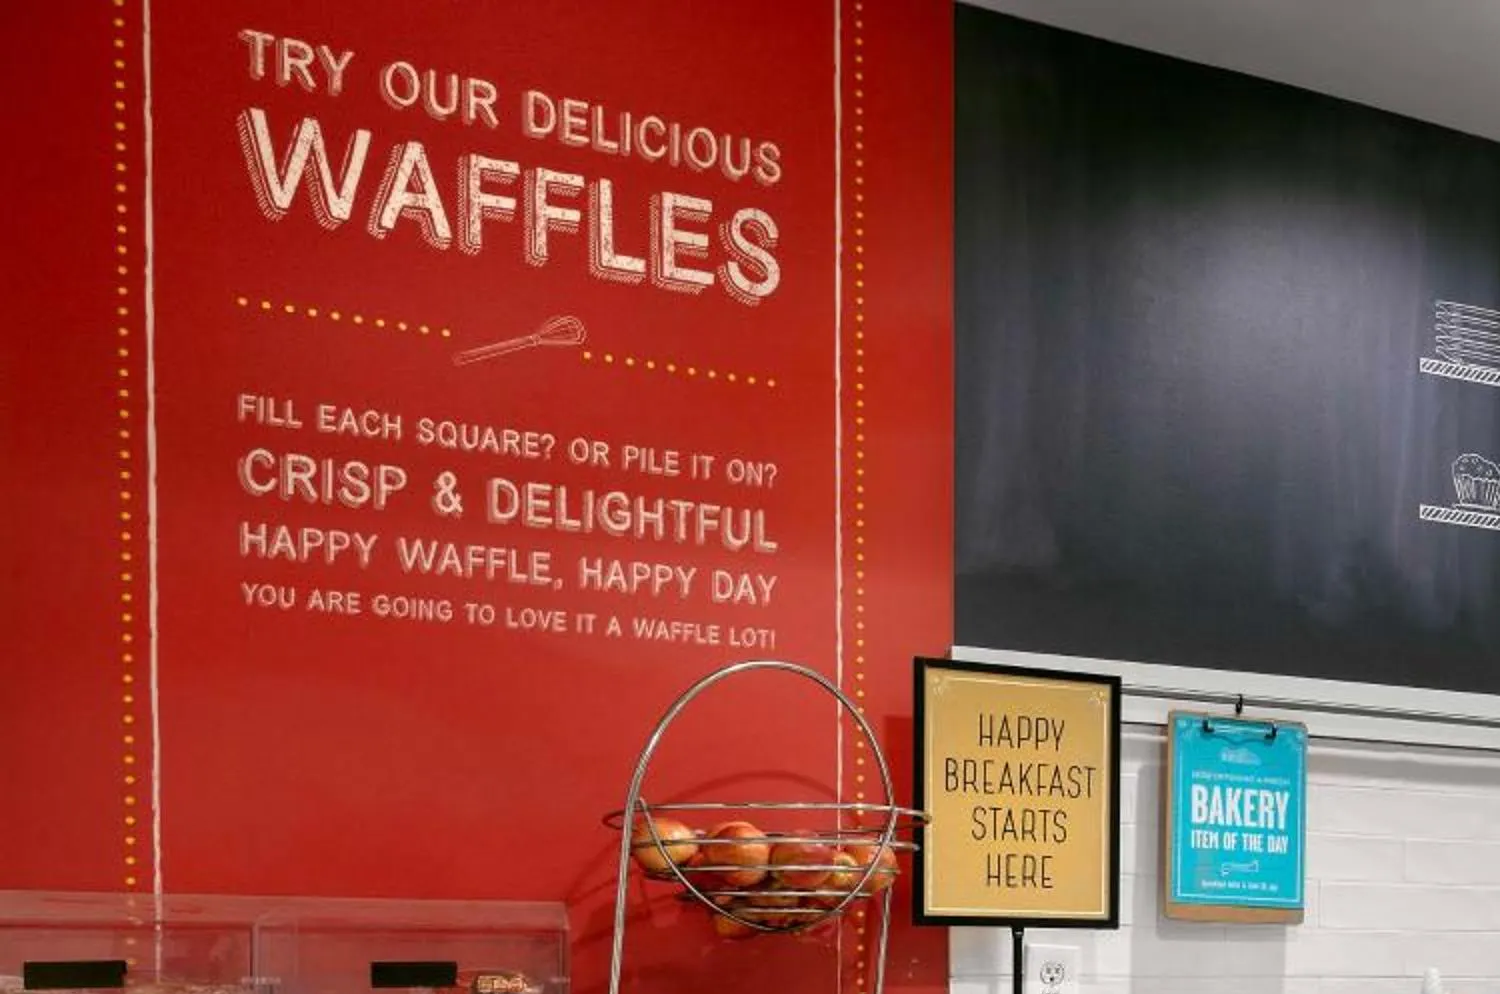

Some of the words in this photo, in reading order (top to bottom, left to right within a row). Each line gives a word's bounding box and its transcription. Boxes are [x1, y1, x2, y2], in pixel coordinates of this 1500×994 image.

[238, 29, 354, 96] TRY
[380, 61, 499, 127] OUR
[522, 90, 782, 184] DELICIOUS
[238, 107, 781, 306] WAFFLES
[238, 393, 303, 430] FILL
[317, 404, 402, 440] EACH
[417, 418, 555, 460] SQUARE?
[570, 437, 609, 465] OR
[623, 447, 679, 476] PILE
[690, 454, 712, 480] IT
[726, 458, 778, 488] ON?
[239, 447, 407, 510] CRISP
[432, 471, 463, 519] &
[486, 477, 779, 553] DELIGHTFUL
[239, 521, 378, 565] HAPPY
[397, 537, 563, 590] WAFFLE,
[579, 556, 697, 598] HAPPY
[710, 570, 778, 605] DAY
[241, 582, 296, 609] YOU
[307, 589, 361, 614] ARE
[373, 594, 453, 622] GOING
[465, 604, 495, 626] TO
[505, 608, 567, 633] LOVE
[576, 612, 596, 635] IT
[606, 616, 622, 637] A
[632, 618, 720, 646] WAFFLE
[729, 627, 776, 649] LOT!
[979, 713, 1066, 751] HAPPY
[945, 757, 1097, 799] BREAKFAST
[1191, 783, 1290, 829] BAKERY
[971, 806, 1068, 844] STARTS
[1191, 829, 1219, 849] ITEM
[1223, 831, 1239, 851] OF
[1242, 833, 1264, 852] THE
[1268, 835, 1289, 854] DAY
[987, 854, 1053, 888] HERE
